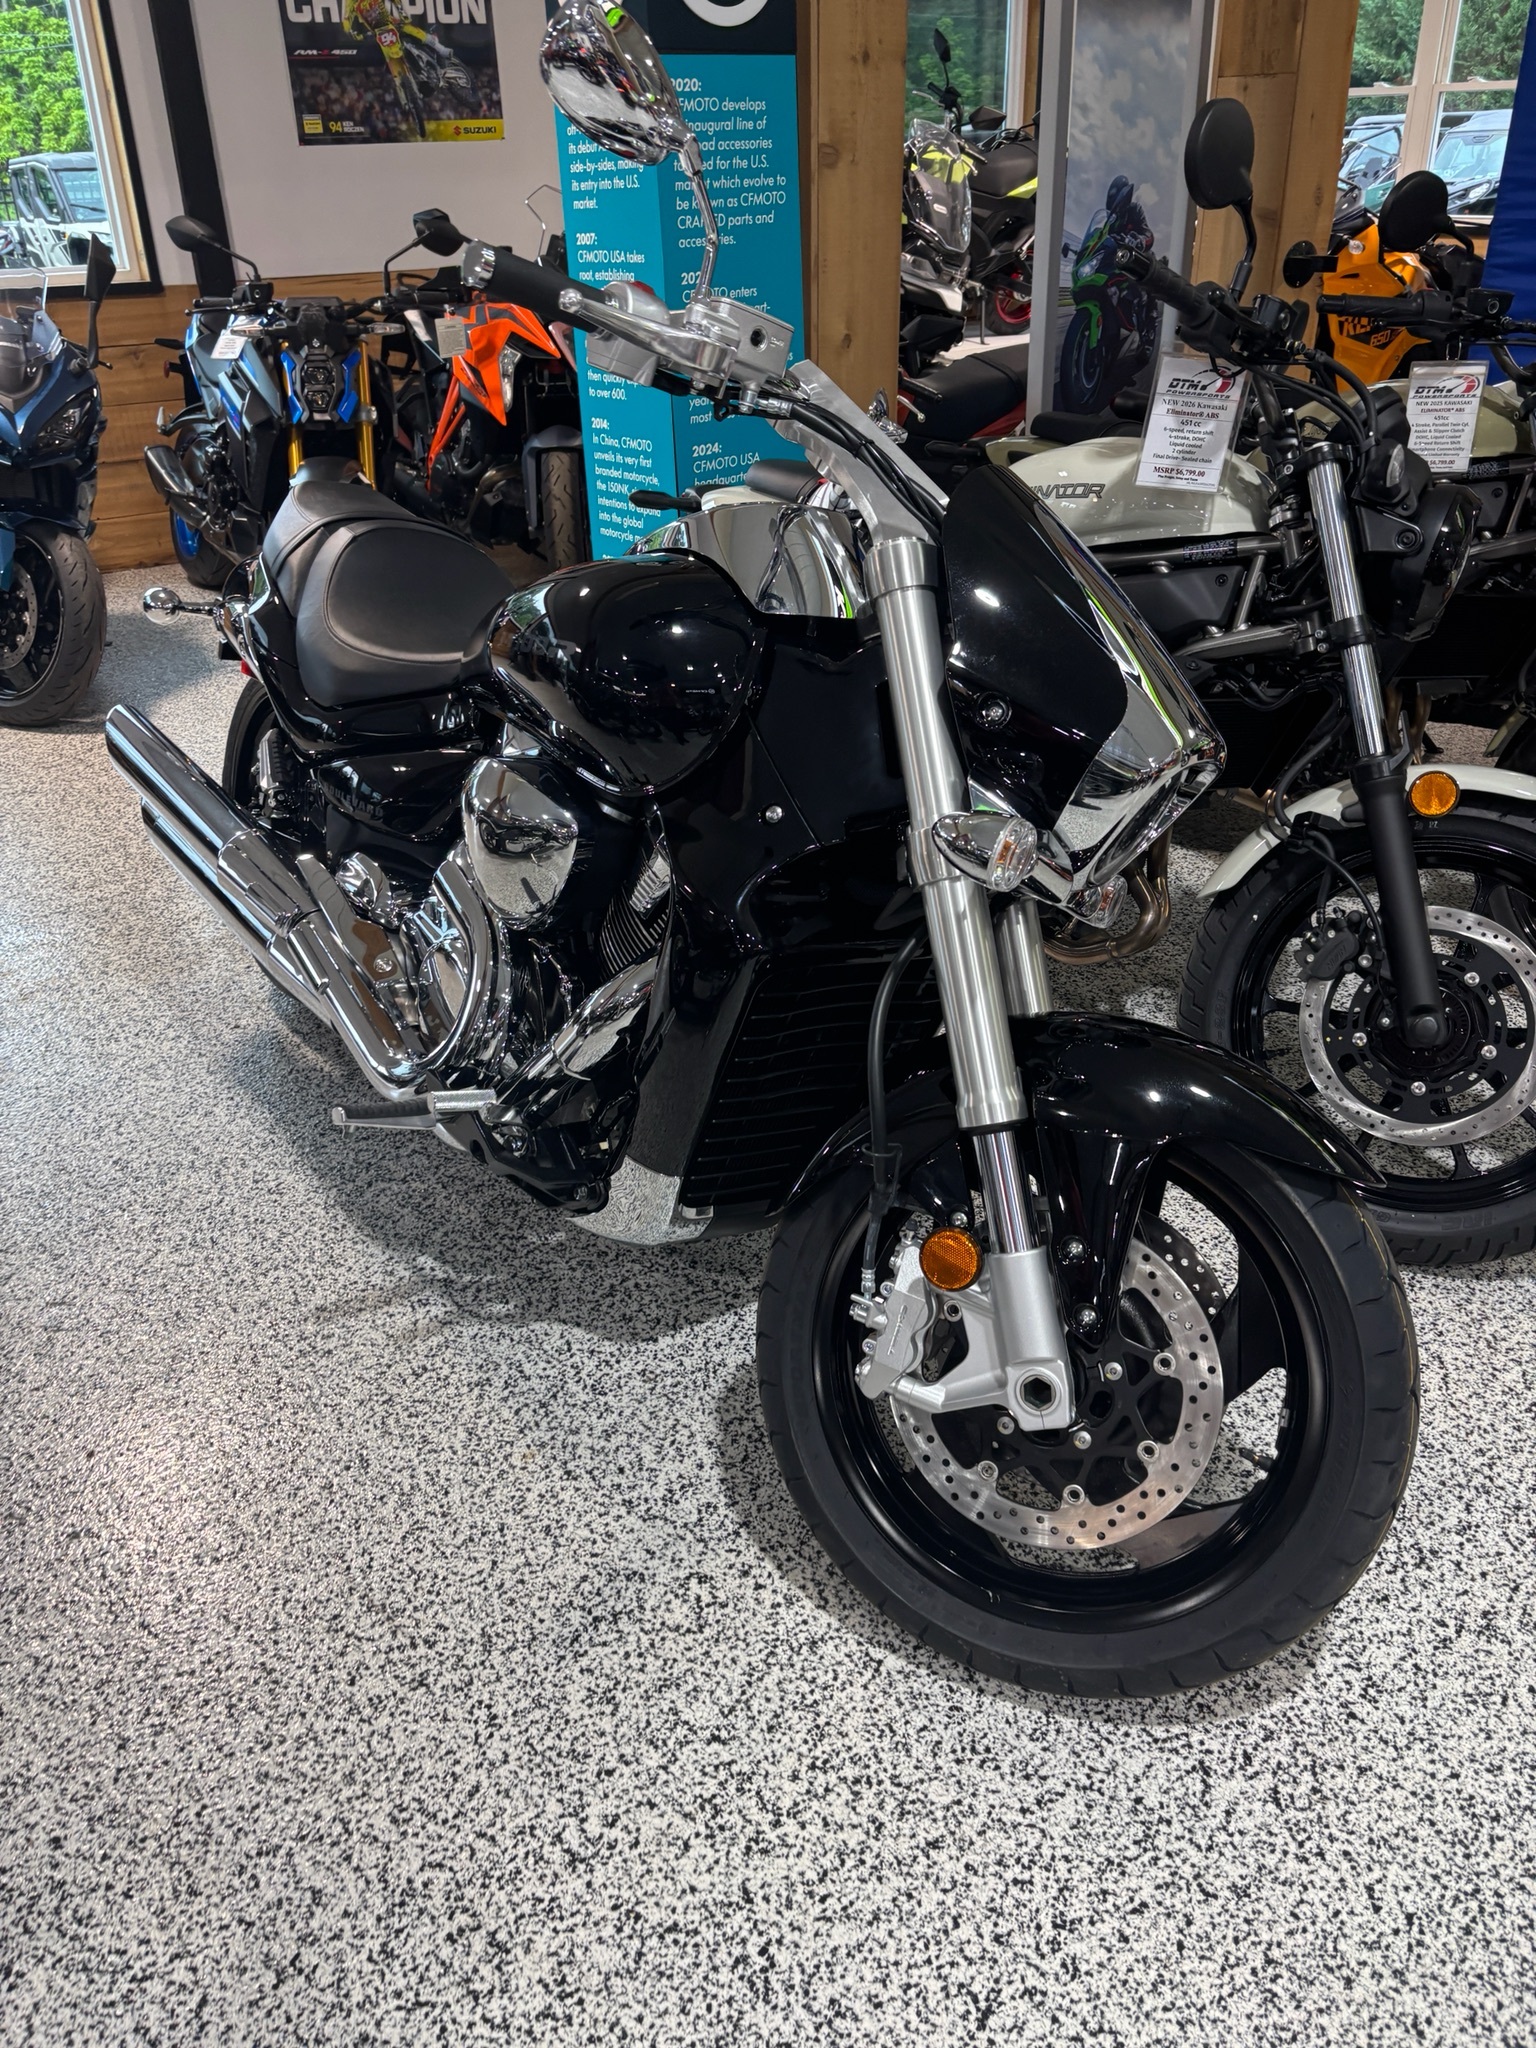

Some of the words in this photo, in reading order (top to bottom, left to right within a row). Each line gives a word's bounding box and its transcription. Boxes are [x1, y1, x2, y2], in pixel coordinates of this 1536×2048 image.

[680, 98, 720, 111] FMOTO
[721, 96, 767, 115] develops
[329, 121, 342, 133] 94
[463, 126, 497, 134] SUZUKI
[736, 116, 754, 130] line
[755, 115, 768, 130] of
[568, 143, 577, 155] its
[718, 137, 773, 151] accessories
[570, 157, 617, 176] side-by-sides,
[716, 156, 731, 170] for
[732, 155, 748, 169] the
[750, 154, 769, 168] U.S.
[571, 179, 580, 191] its
[580, 178, 598, 194] entry
[599, 178, 612, 190] into
[613, 175, 625, 189] the
[625, 174, 640, 189] U.S.
[712, 174, 741, 189] which
[742, 173, 774, 188] evolve
[776, 173, 787, 186] to
[573, 196, 598, 210] market.
[676, 196, 690, 210] be
[726, 197, 738, 207] as
[740, 191, 787, 207] CFMOTO
[728, 213, 753, 231] parts
[755, 209, 775, 224] and
[576, 232, 598, 246] 2007:
[577, 250, 609, 263] CFMOTO
[610, 250, 626, 263] USA
[626, 250, 645, 263] takes
[579, 269, 594, 282] root,
[594, 268, 635, 283] establishing
[730, 285, 758, 300] enters
[1370, 329, 1391, 347] 650
[587, 368, 602, 381] then
[1168, 378, 1202, 391] DTM
[1414, 386, 1447, 394] DTM
[589, 387, 596, 397] to
[596, 390, 611, 399] over
[611, 388, 627, 400] 600.
[1166, 389, 1231, 399] POWERSPORTS
[1163, 398, 1180, 406] NEW
[1181, 400, 1196, 408] 2026
[1197, 402, 1228, 411] Kawasaki
[591, 417, 610, 430] 2014:
[690, 411, 713, 425] most
[1180, 419, 1193, 427] 451
[592, 432, 599, 444] In
[600, 433, 621, 449] China,
[621, 436, 653, 453] CFMOTO
[692, 442, 723, 458] 2024:
[593, 451, 615, 463] unveils
[615, 453, 624, 464] its
[624, 455, 639, 469] very
[639, 454, 652, 468] first
[693, 455, 738, 474] CFMOTO
[740, 451, 760, 468] USA
[595, 463, 622, 479] branded
[622, 471, 660, 487] motorcycle,
[1153, 466, 1175, 474] MSRP
[1175, 468, 1206, 478] $6,799.00
[596, 479, 607, 491] the
[597, 495, 628, 510] intentions
[598, 510, 611, 522] into
[611, 512, 622, 524] the
[622, 515, 644, 529] global
[600, 527, 634, 543] motorcycle
